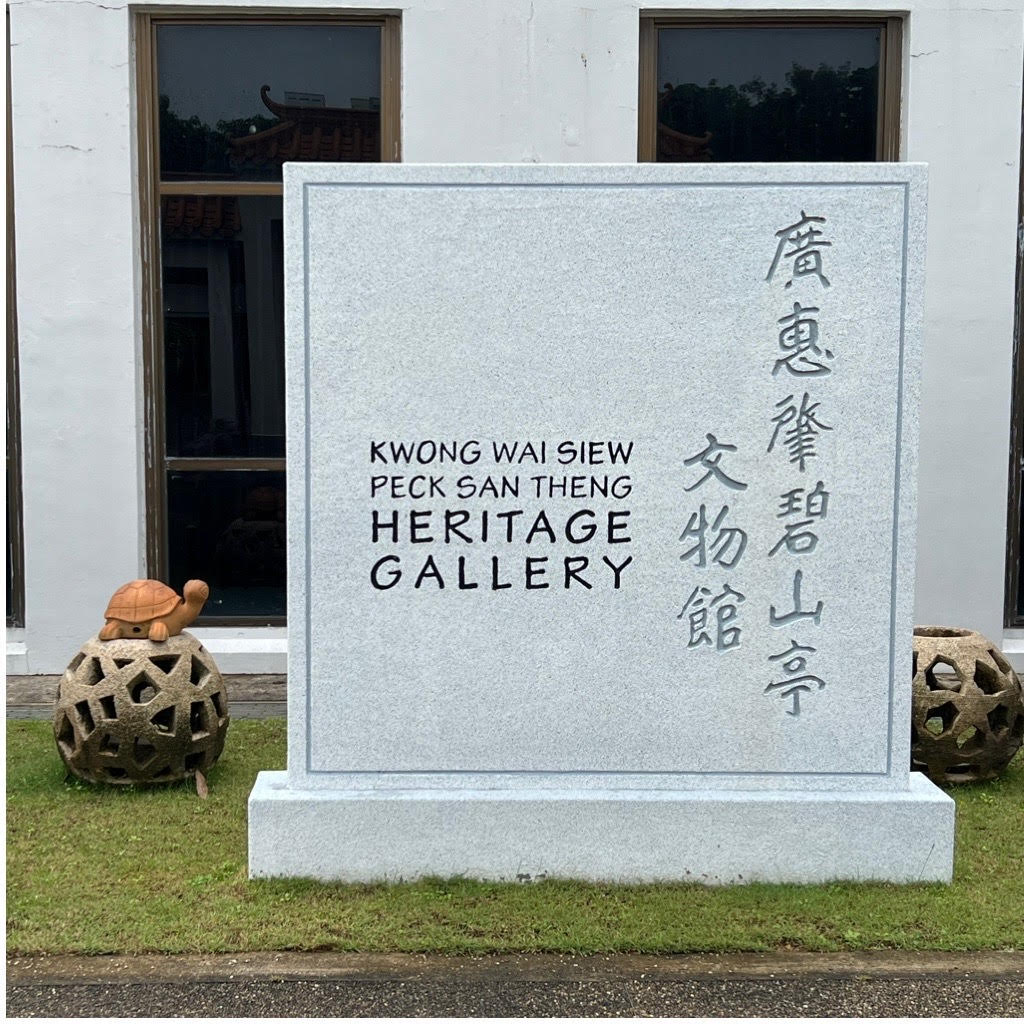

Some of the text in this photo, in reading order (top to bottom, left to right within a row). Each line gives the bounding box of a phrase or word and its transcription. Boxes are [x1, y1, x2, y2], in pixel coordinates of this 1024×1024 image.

[370, 440, 634, 466] KWONG WAI SIEW
[764, 210, 835, 718] 廣惠肇碧山亭
[370, 475, 632, 500] PECK SAN THENG
[371, 509, 632, 545] HERITAGE
[677, 433, 749, 652] 文物館
[370, 554, 633, 591] GALLERY
